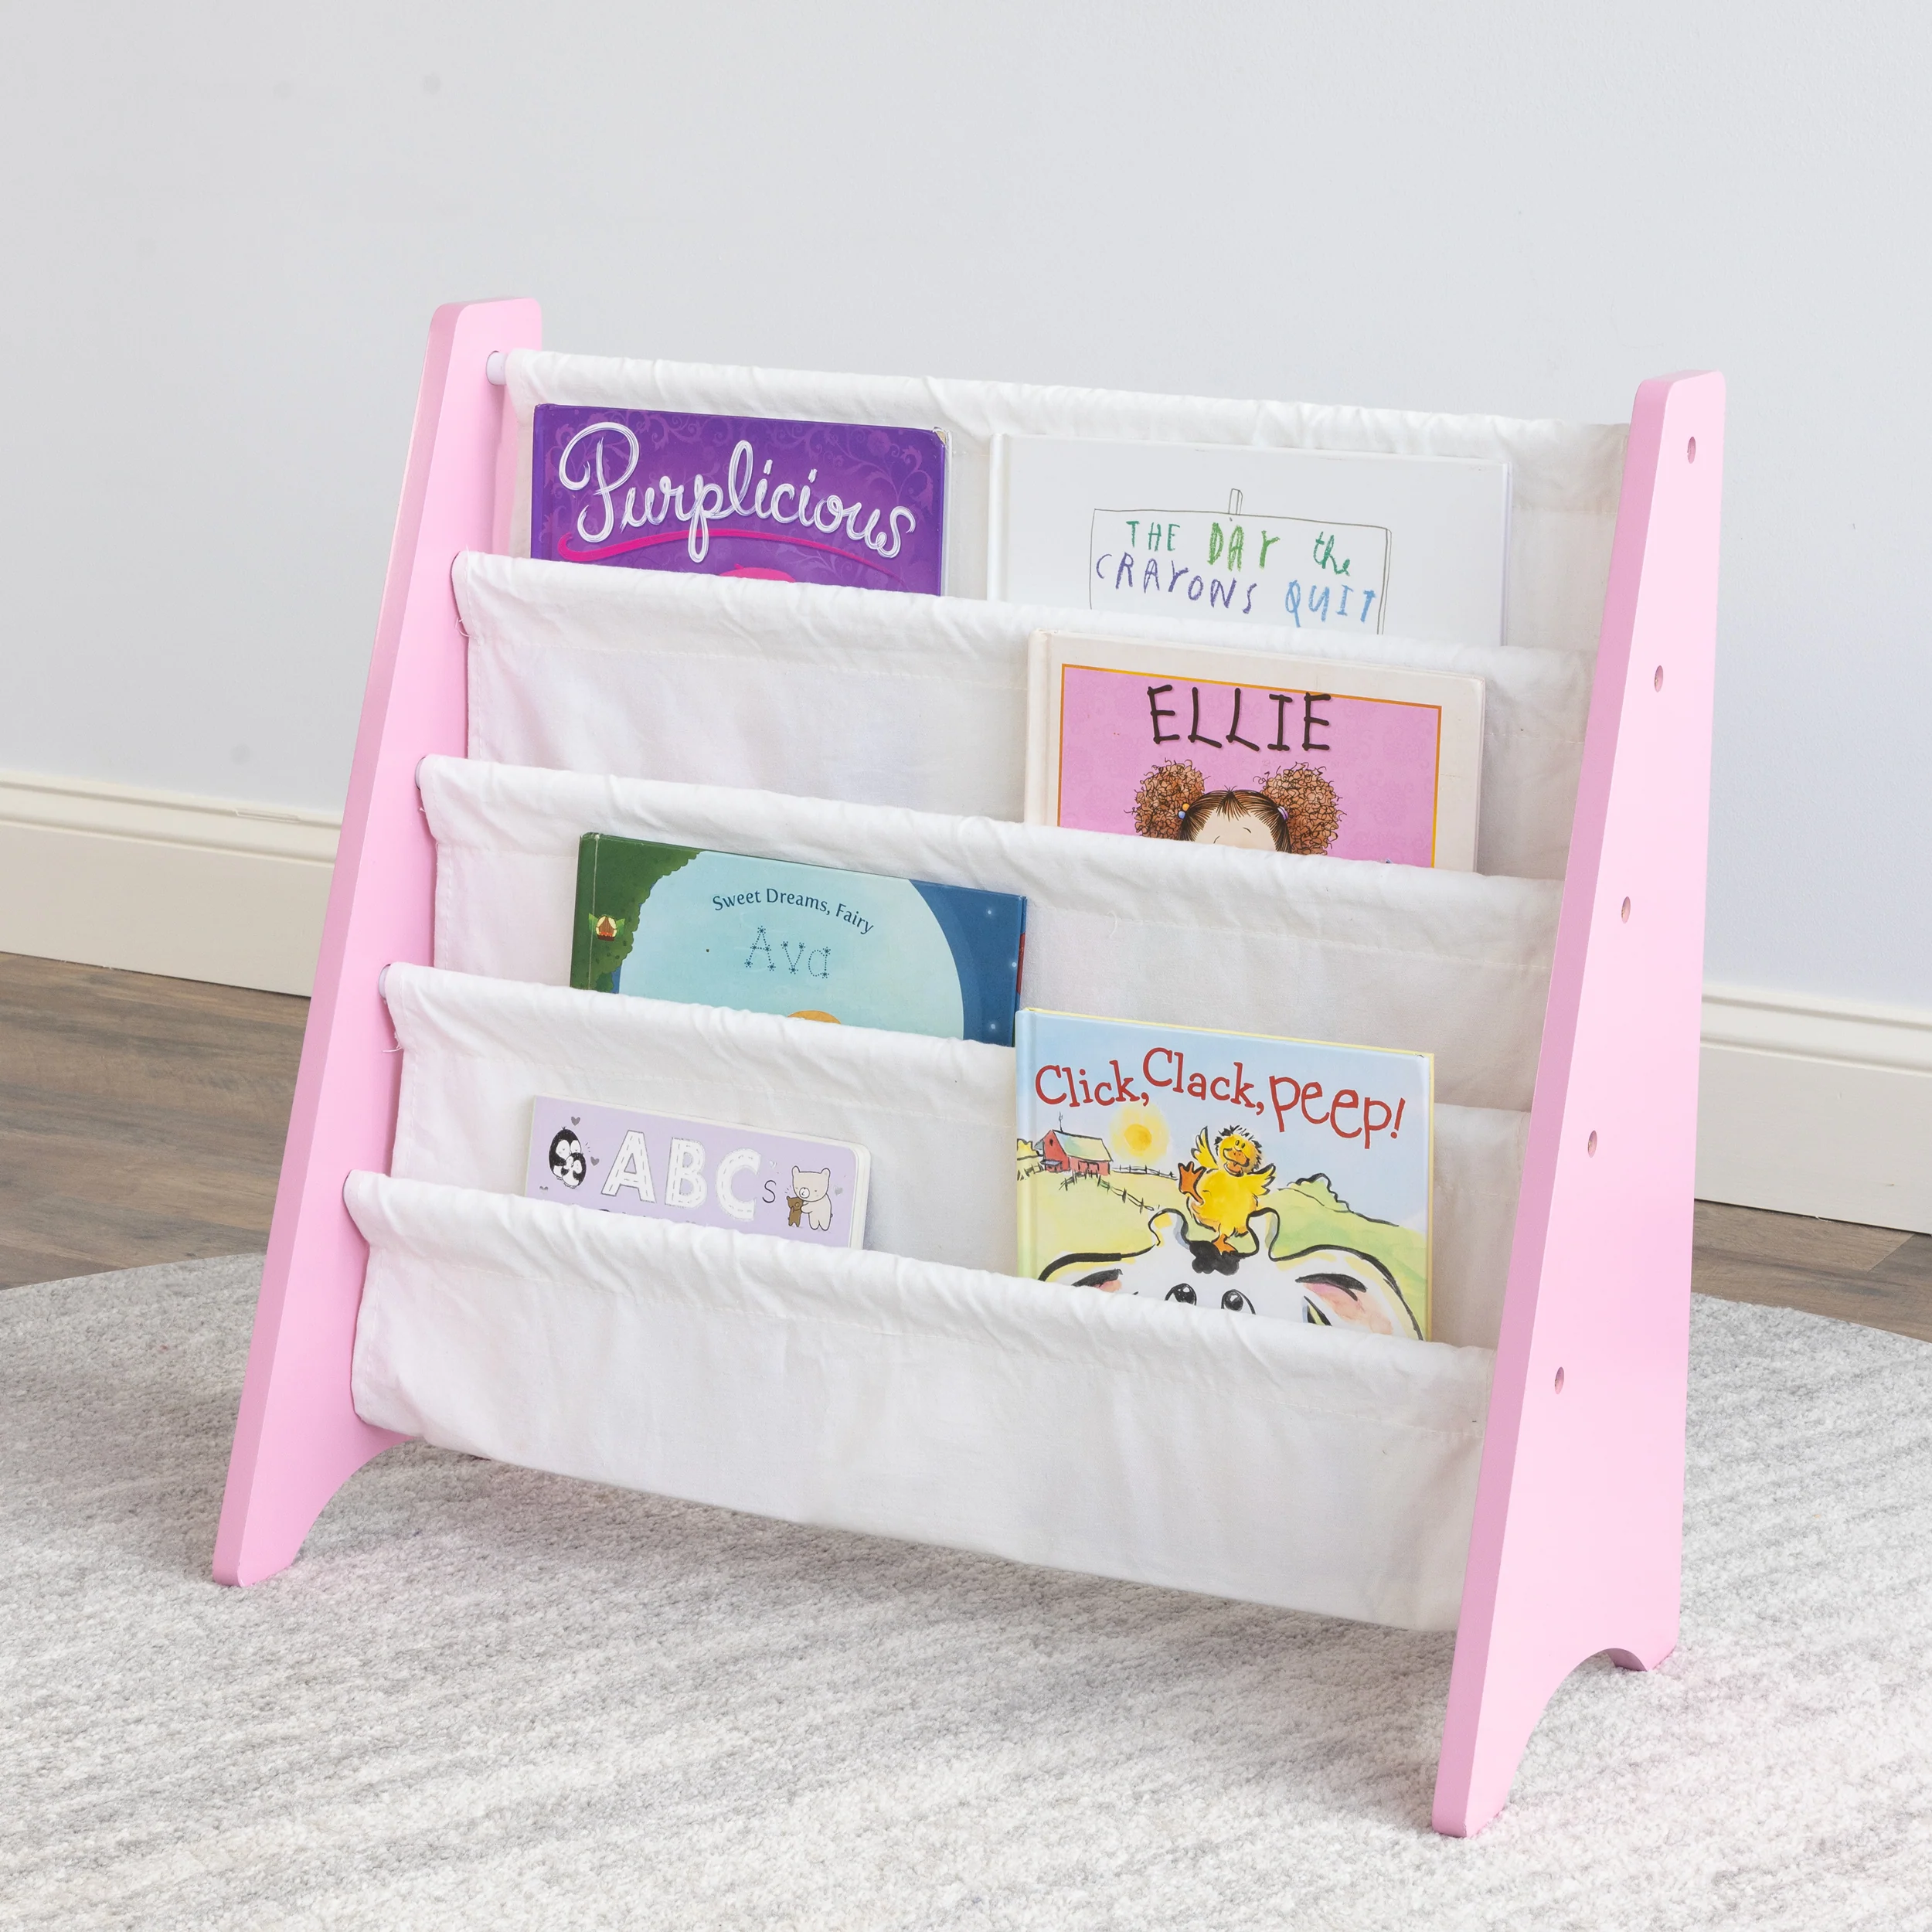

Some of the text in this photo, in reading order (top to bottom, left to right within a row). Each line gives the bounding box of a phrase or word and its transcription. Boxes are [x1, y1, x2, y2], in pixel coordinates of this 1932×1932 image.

[558, 421, 915, 563] Purplicious
[1126, 520, 1351, 577] THE DAY the
[1096, 552, 1376, 628] CRAYONS QUIT
[1147, 684, 1332, 752] ELLIE
[713, 888, 874, 935] Sweet Dreams, Fairy
[744, 925, 831, 978] Ava
[1035, 1060, 1150, 1107] Click,
[1142, 1046, 1265, 1116] Clack,
